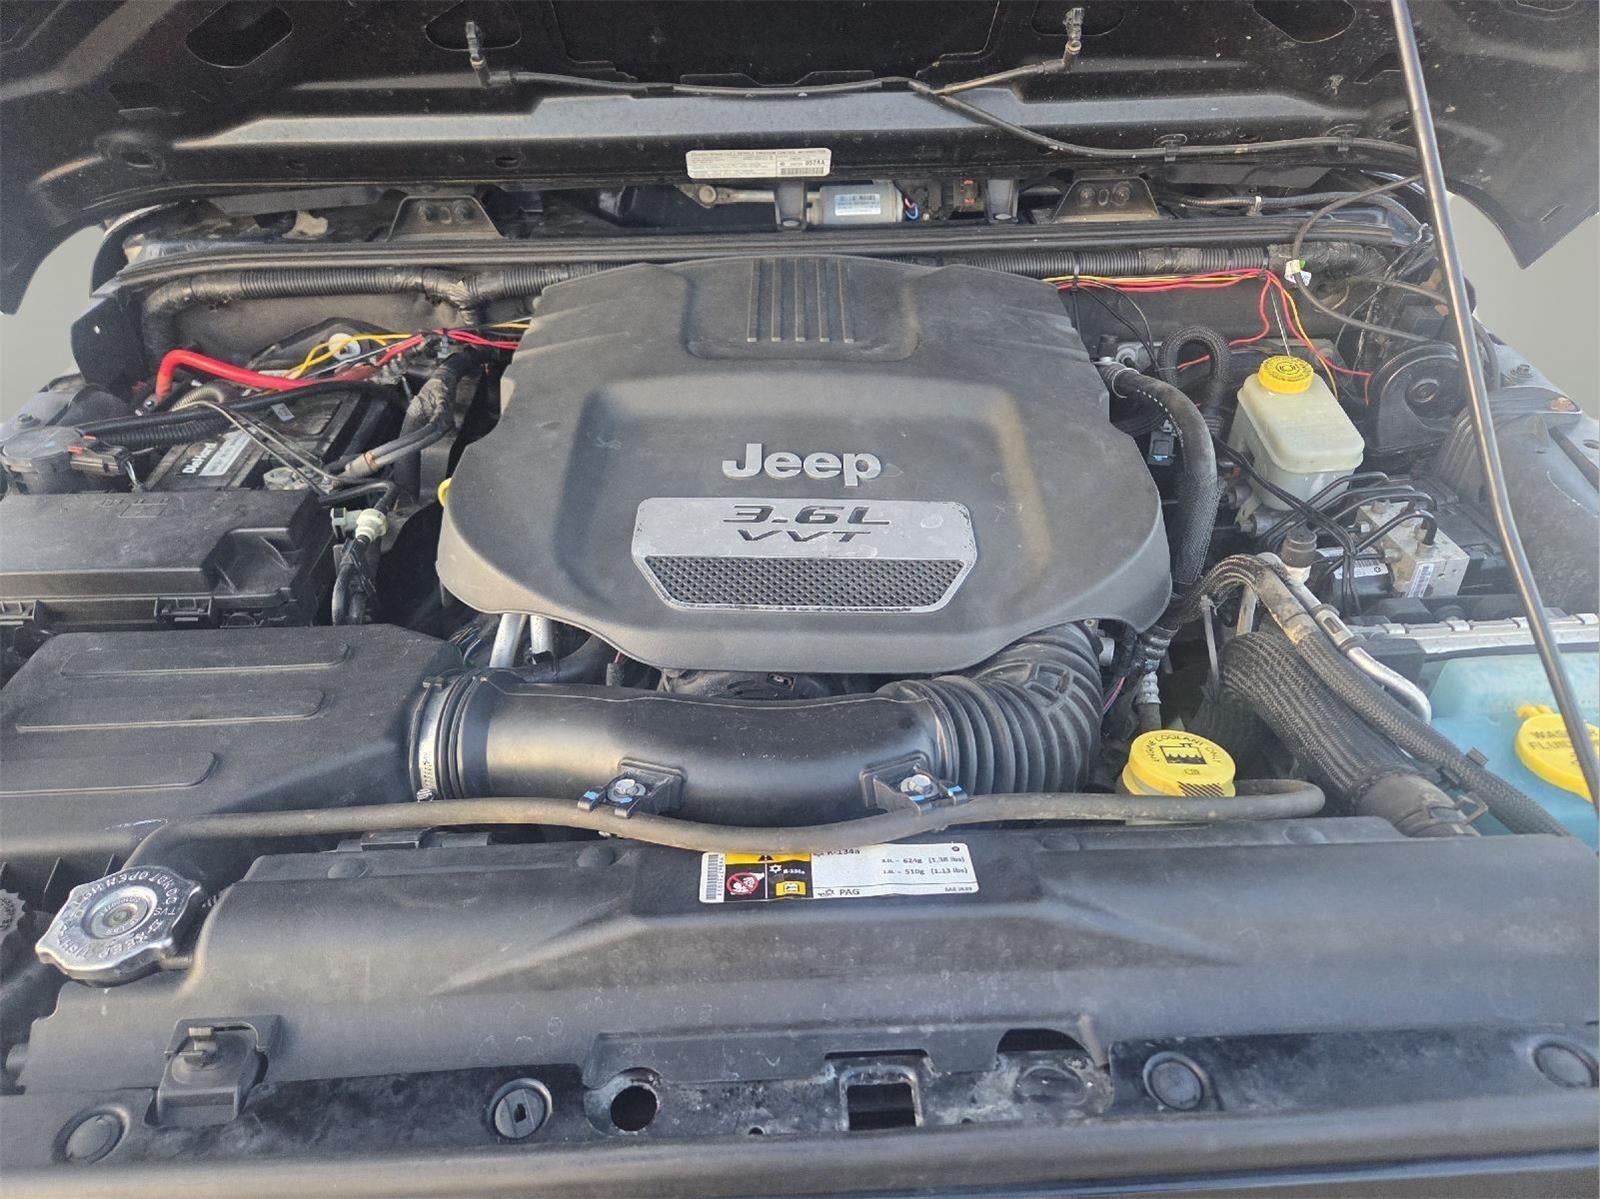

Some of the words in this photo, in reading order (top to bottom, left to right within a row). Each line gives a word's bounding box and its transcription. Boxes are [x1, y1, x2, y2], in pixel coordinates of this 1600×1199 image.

[722, 443, 882, 486] Jeep
[723, 505, 890, 525] 3.6L
[737, 529, 872, 542] VVT
[1155, 734, 1203, 747] COOLANT
[106, 871, 149, 887] OPEN
[148, 873, 175, 891] NOT
[838, 888, 861, 896] PAG
[153, 907, 176, 916] TVS
